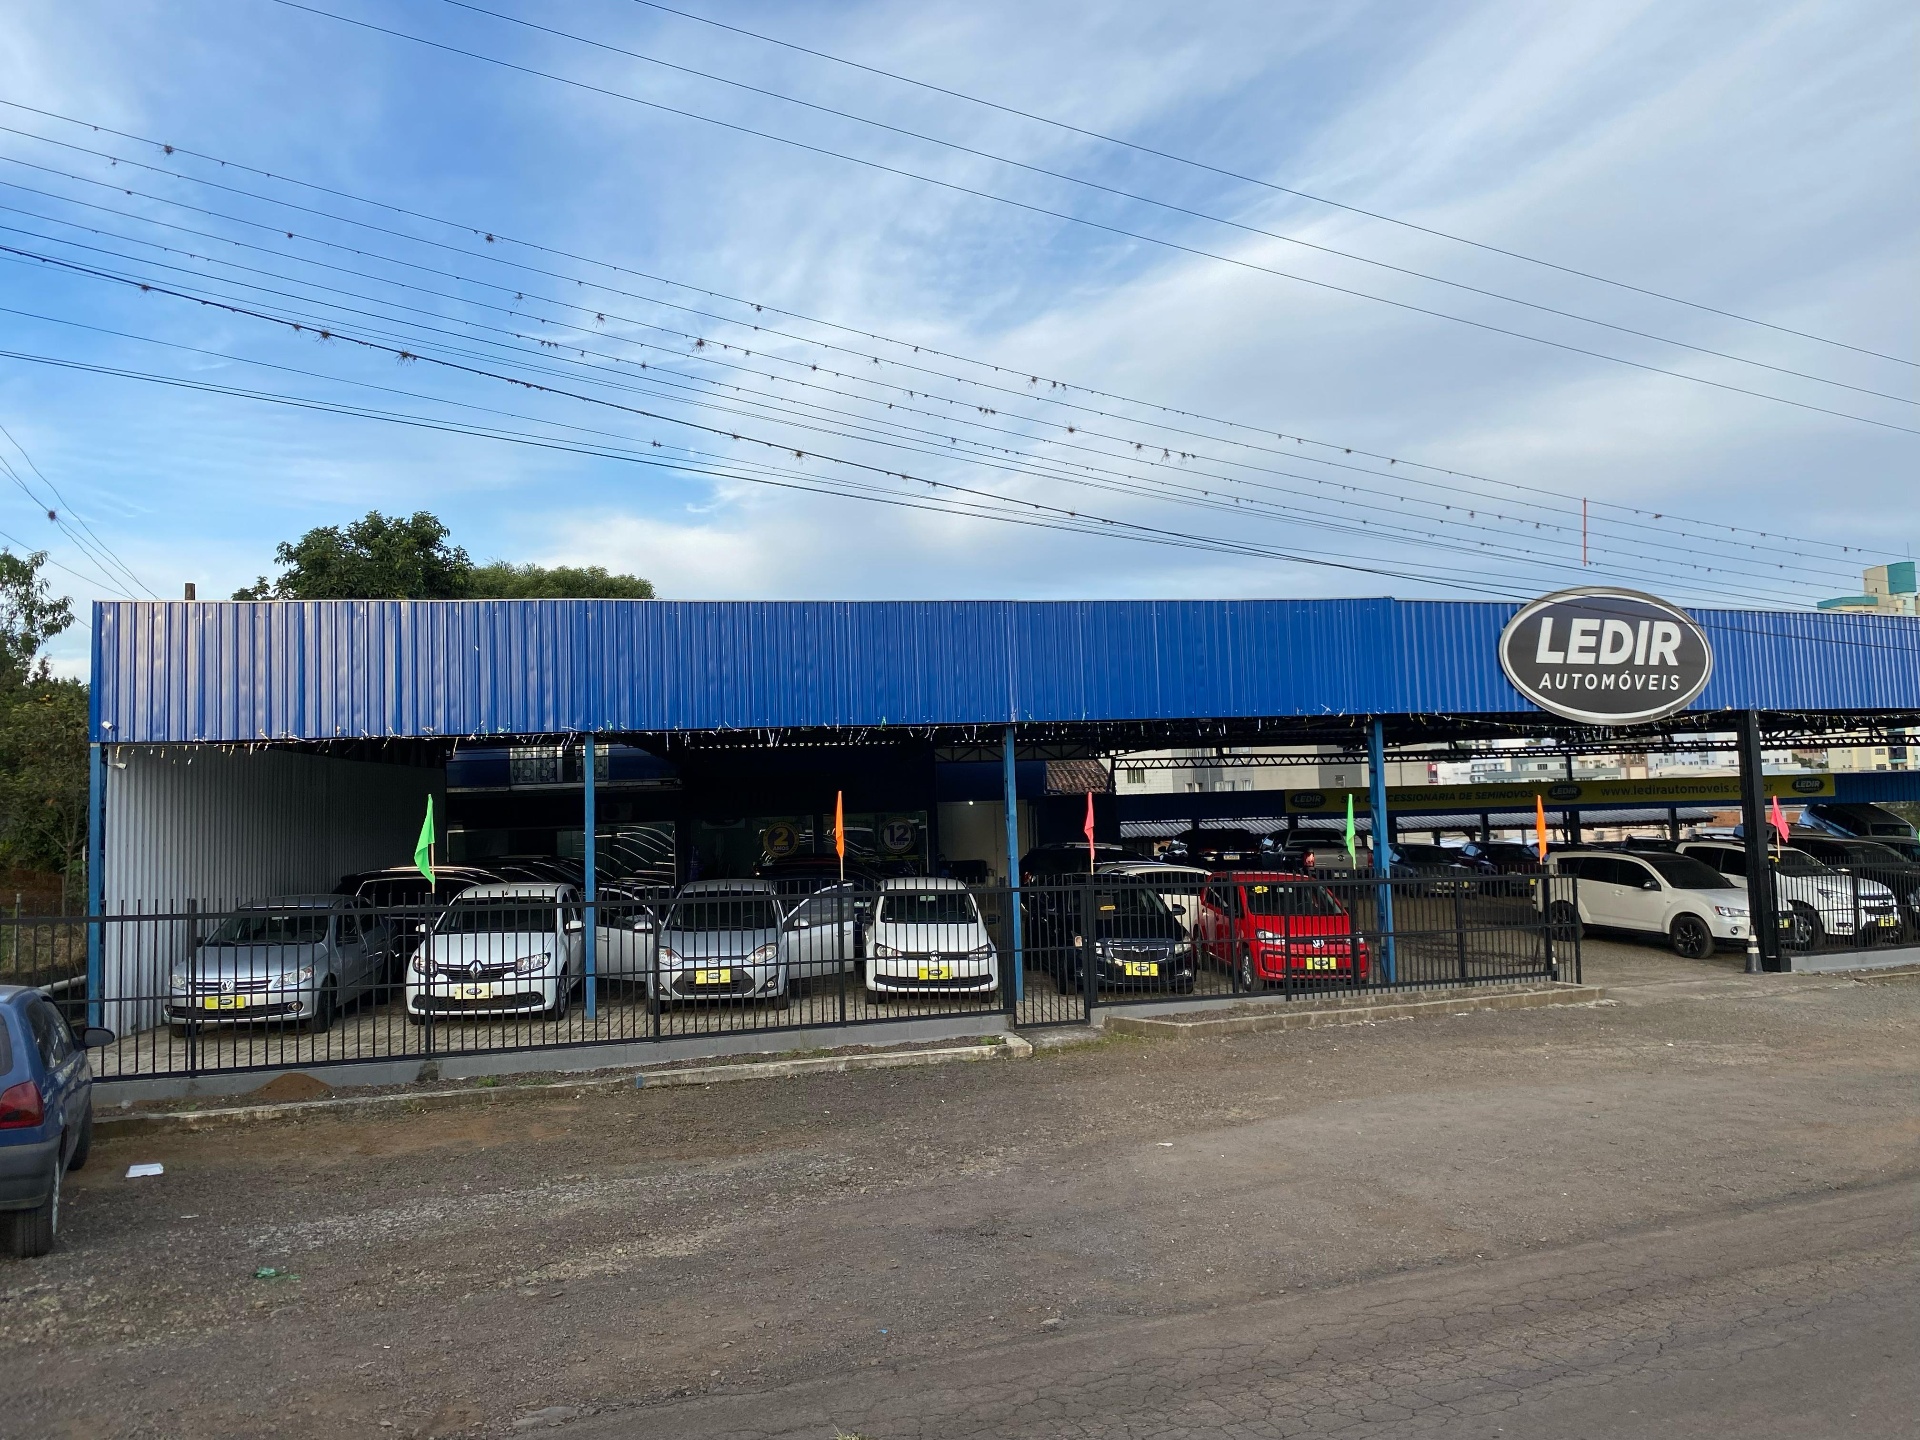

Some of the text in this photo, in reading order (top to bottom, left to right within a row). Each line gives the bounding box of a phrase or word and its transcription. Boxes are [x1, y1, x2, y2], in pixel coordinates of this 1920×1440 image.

[1536, 617, 1681, 666] LEDIR
[1539, 670, 1680, 691] AUTOMÓVEIS
[1552, 787, 1578, 795] LEDIR
[1795, 780, 1821, 788] LEDIR
[1294, 795, 1322, 803] LEDIR
[1340, 795, 1361, 804] SA
[1458, 791, 1473, 800] DE
[1475, 789, 1534, 800] SEMINOVOS
[773, 826, 789, 846] 2
[887, 825, 909, 843] 12
